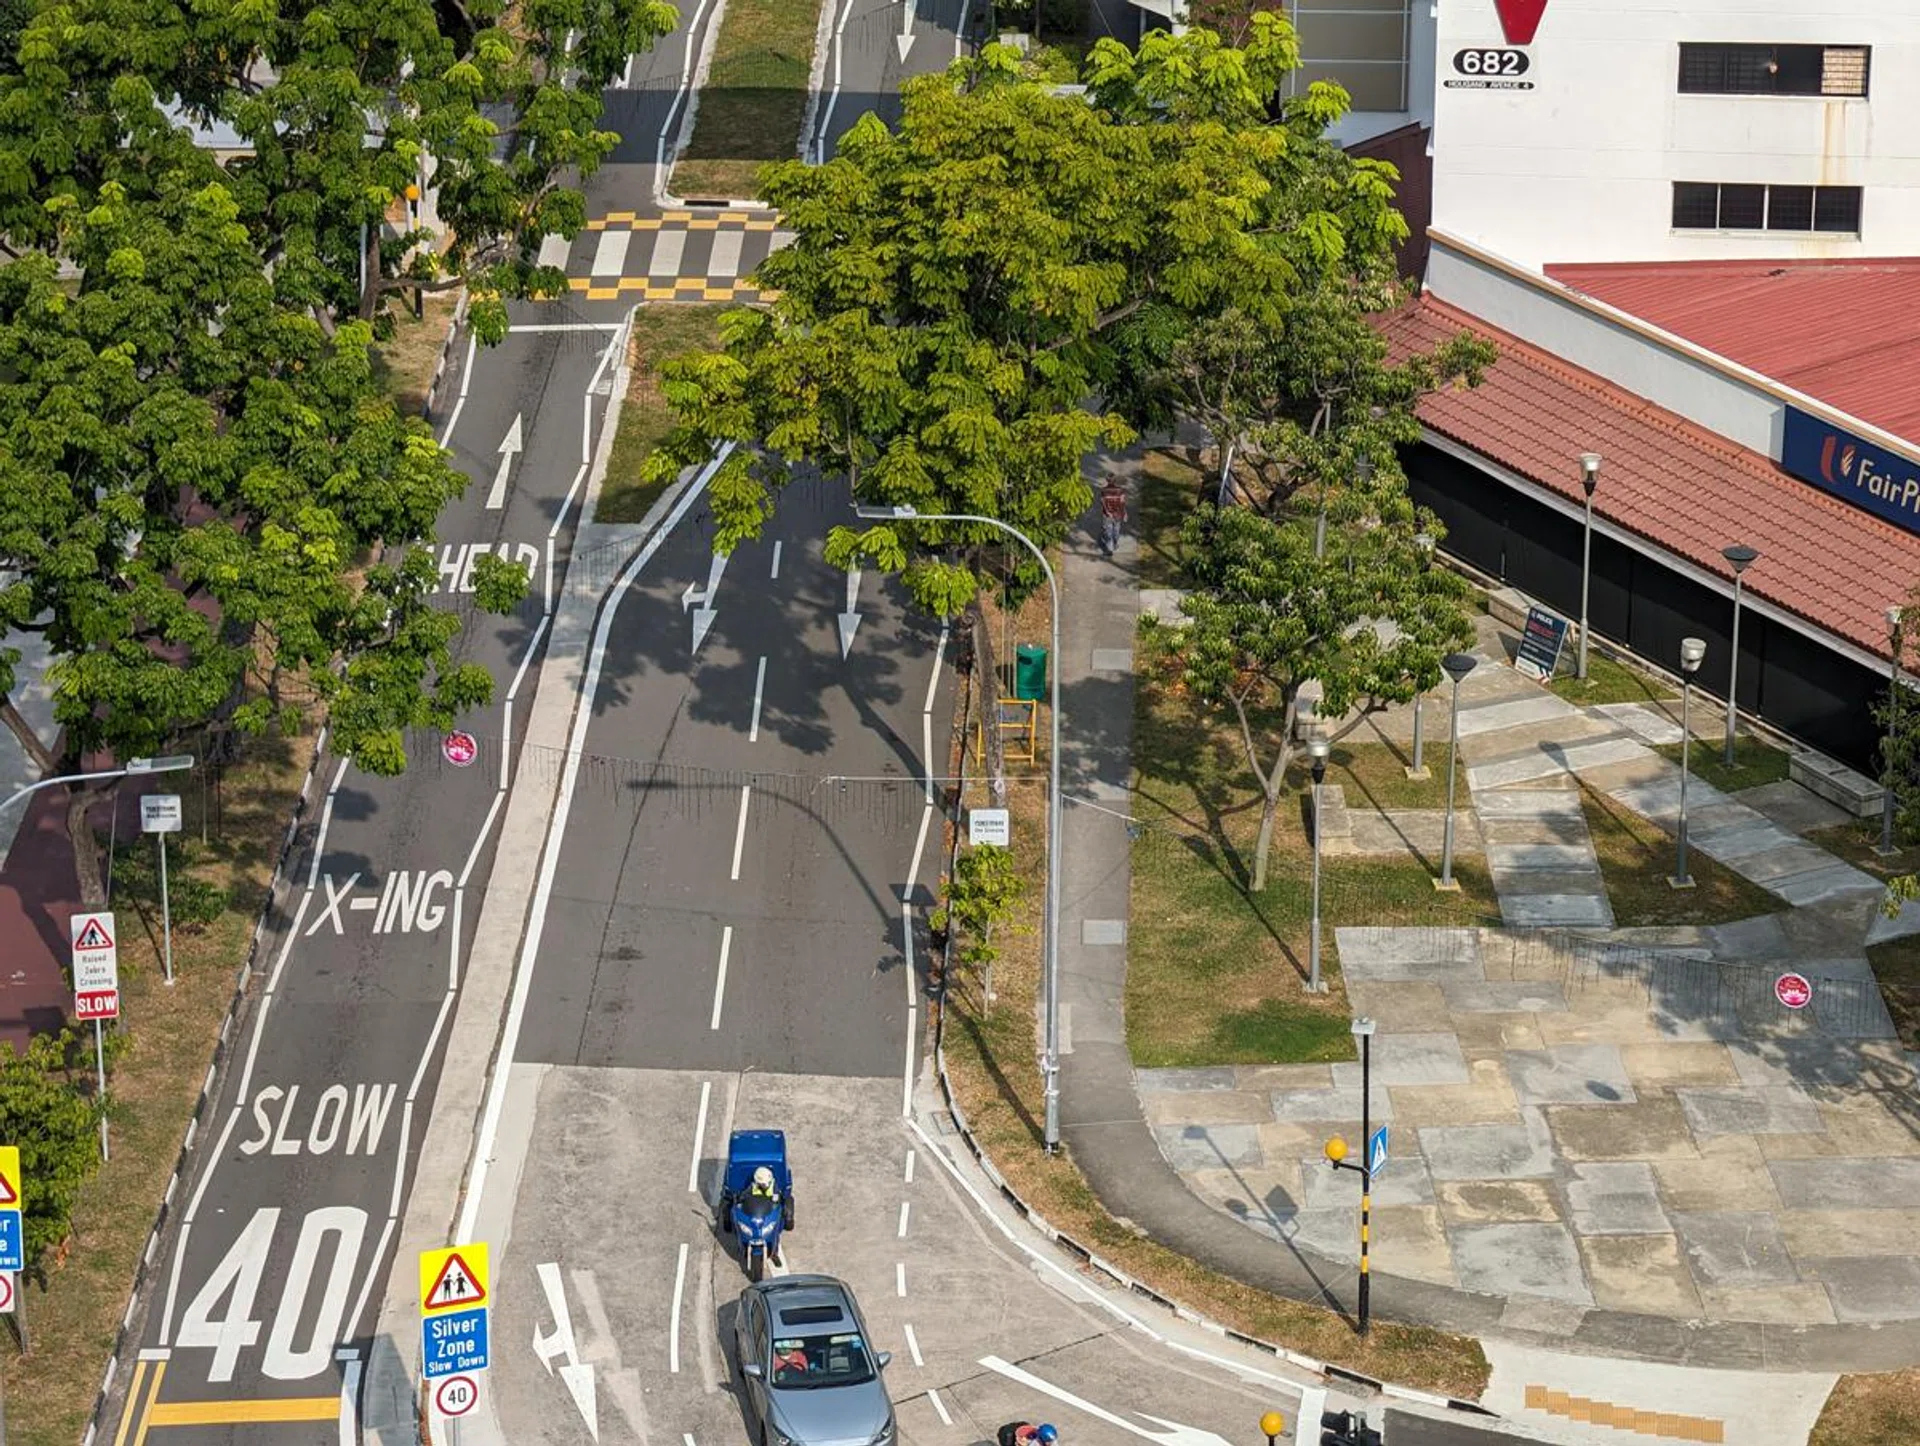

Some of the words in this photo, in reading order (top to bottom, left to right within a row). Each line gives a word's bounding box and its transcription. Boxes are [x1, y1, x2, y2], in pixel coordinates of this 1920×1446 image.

[1463, 51, 1519, 75] 682
[305, 870, 453, 935] X-ING
[78, 996, 117, 1012] SLOW
[239, 1084, 398, 1155] SLOW
[175, 1206, 368, 1382] 40
[432, 1318, 479, 1338] Silver
[437, 1339, 475, 1358] Zone
[428, 1361, 453, 1373] Slow
[458, 1355, 485, 1368] Down
[448, 1387, 467, 1404] 40
